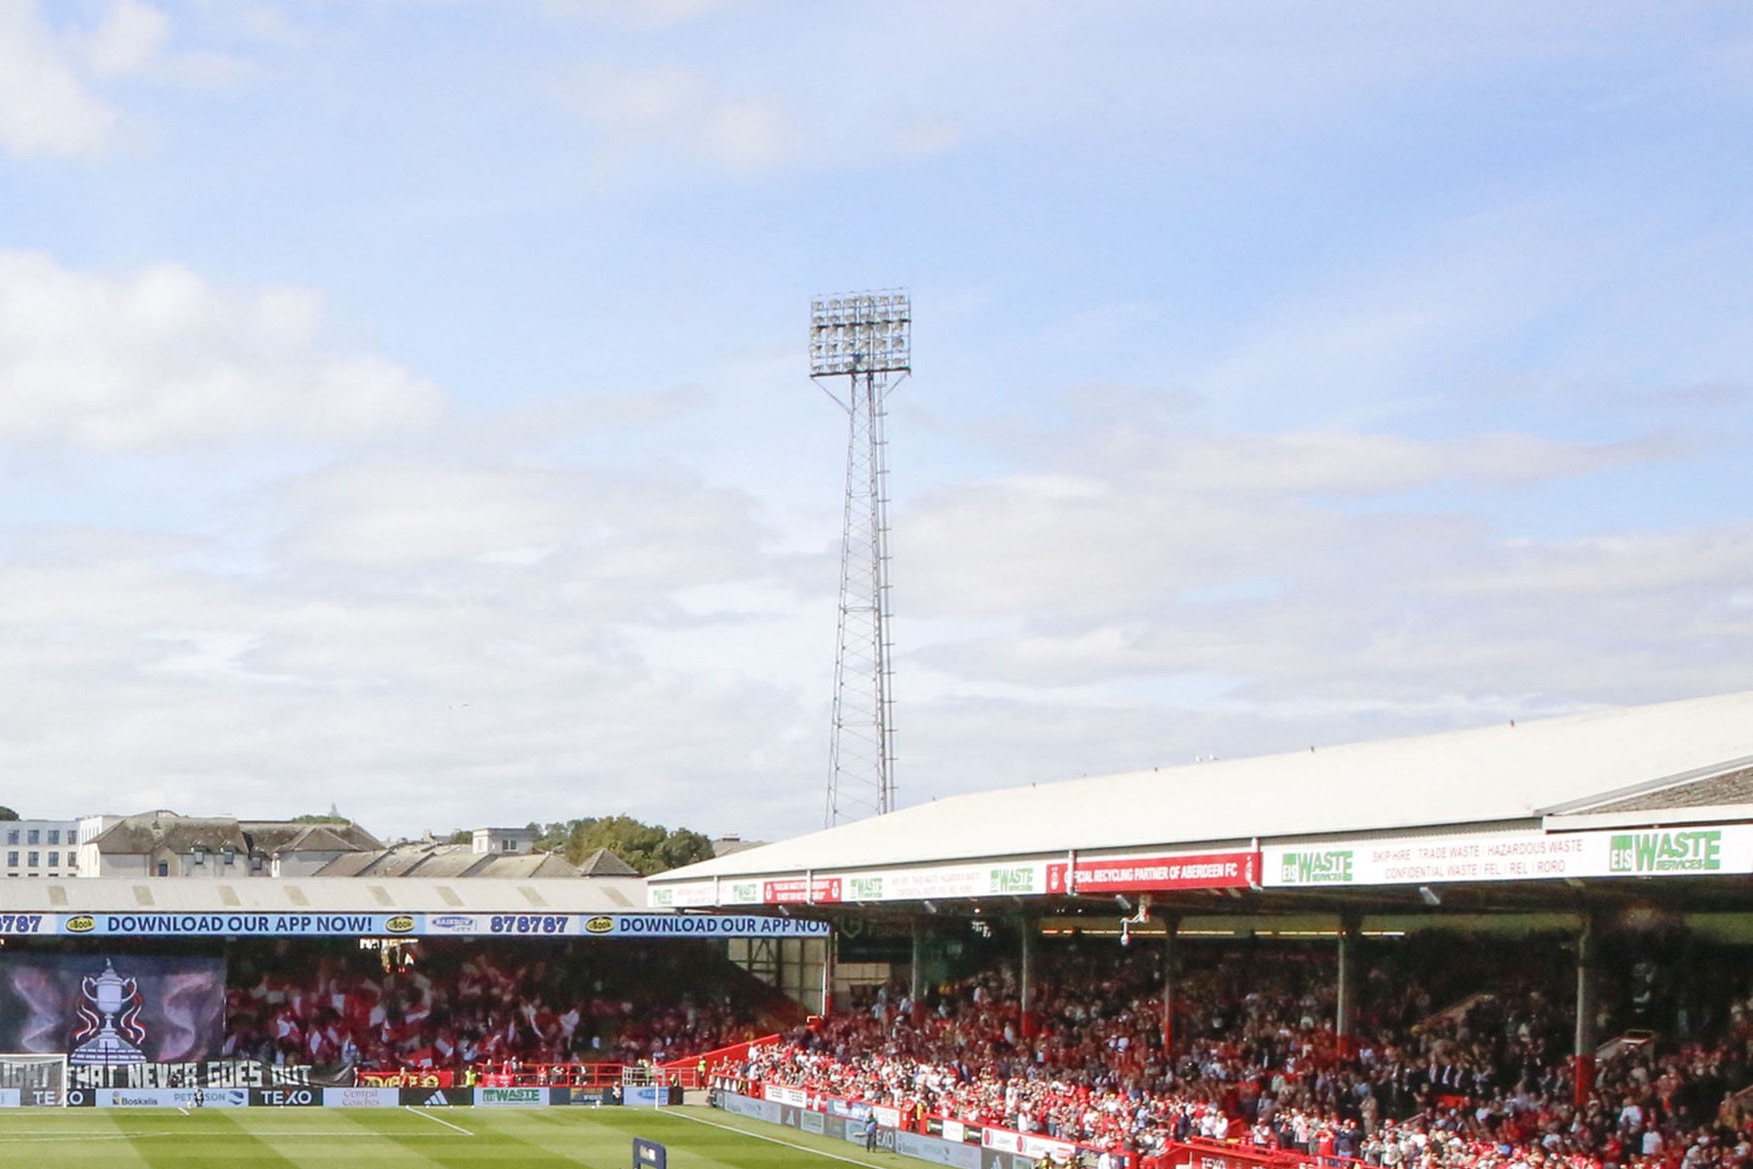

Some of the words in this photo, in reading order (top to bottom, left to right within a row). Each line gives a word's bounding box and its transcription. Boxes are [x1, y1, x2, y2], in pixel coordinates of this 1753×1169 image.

[1418, 847, 1448, 860] TRADE
[1450, 844, 1480, 858] WASTE
[1488, 842, 1546, 857] HAZARDOUS
[1548, 838, 1583, 853] WASTE
[1634, 831, 1722, 872] WASTE
[1095, 867, 1133, 883] RECYCLING
[1134, 866, 1168, 882] PARTNER
[1169, 865, 1180, 880] OF
[1181, 864, 1225, 879] ABERDEEN
[1226, 862, 1238, 877] FC
[1297, 850, 1354, 883] WASTE
[1384, 865, 1444, 880] CONFIDENTIAL
[1447, 862, 1479, 876] WASTE
[1537, 859, 1566, 873] RORO
[108, 916, 221, 932] DOWNLOAD
[228, 916, 269, 932] OUR
[275, 916, 311, 932] APP
[316, 916, 372, 932] NOW!
[491, 916, 569, 933] 878787
[619, 917, 718, 932] DOWNLOAD
[721, 918, 757, 932] OUR
[760, 919, 791, 933] APP
[128, 1062, 197, 1088] NEVER
[207, 1061, 262, 1087] GOES
[174, 1091, 226, 1102] PETSON
[259, 1090, 312, 1105] TEXO
[343, 1088, 378, 1098] Central
[495, 1089, 540, 1101] WASTE
[875, 1128, 894, 1149] EXO
